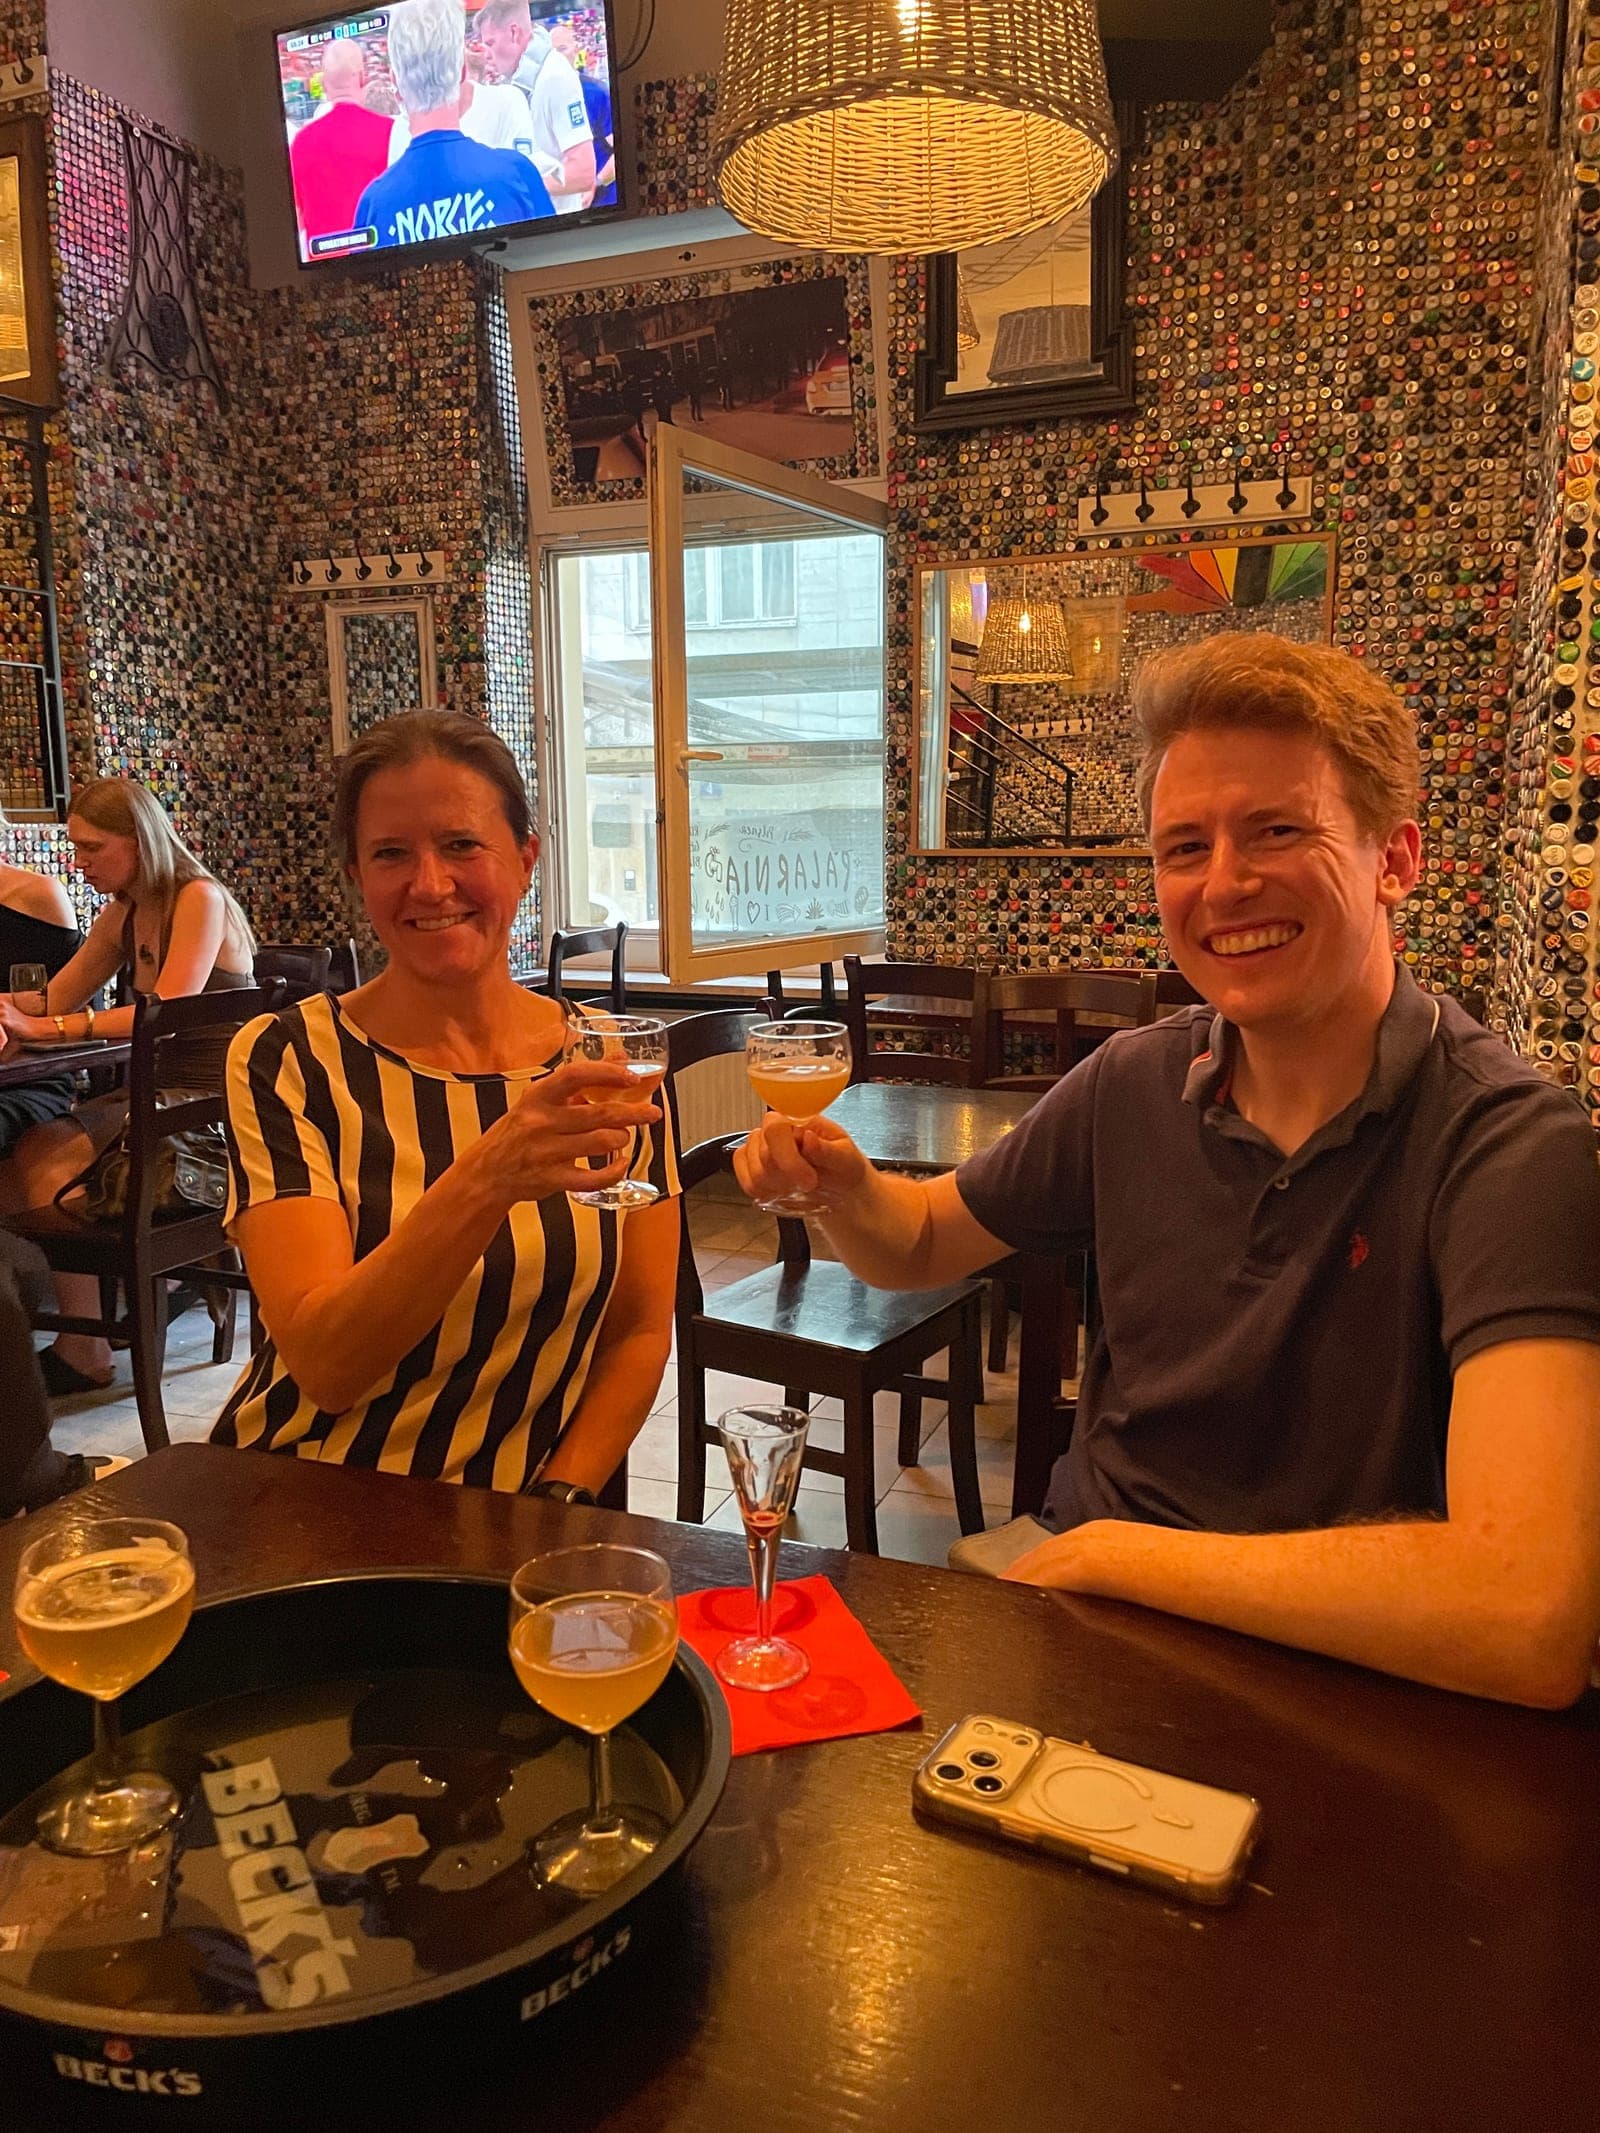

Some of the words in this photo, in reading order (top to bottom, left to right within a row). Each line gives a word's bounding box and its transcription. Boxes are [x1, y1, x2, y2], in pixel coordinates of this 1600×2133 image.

[202, 1757, 357, 2010] BECK'S
[521, 1925, 631, 2020] BECK'S
[54, 2053, 203, 2096] BECK'S
